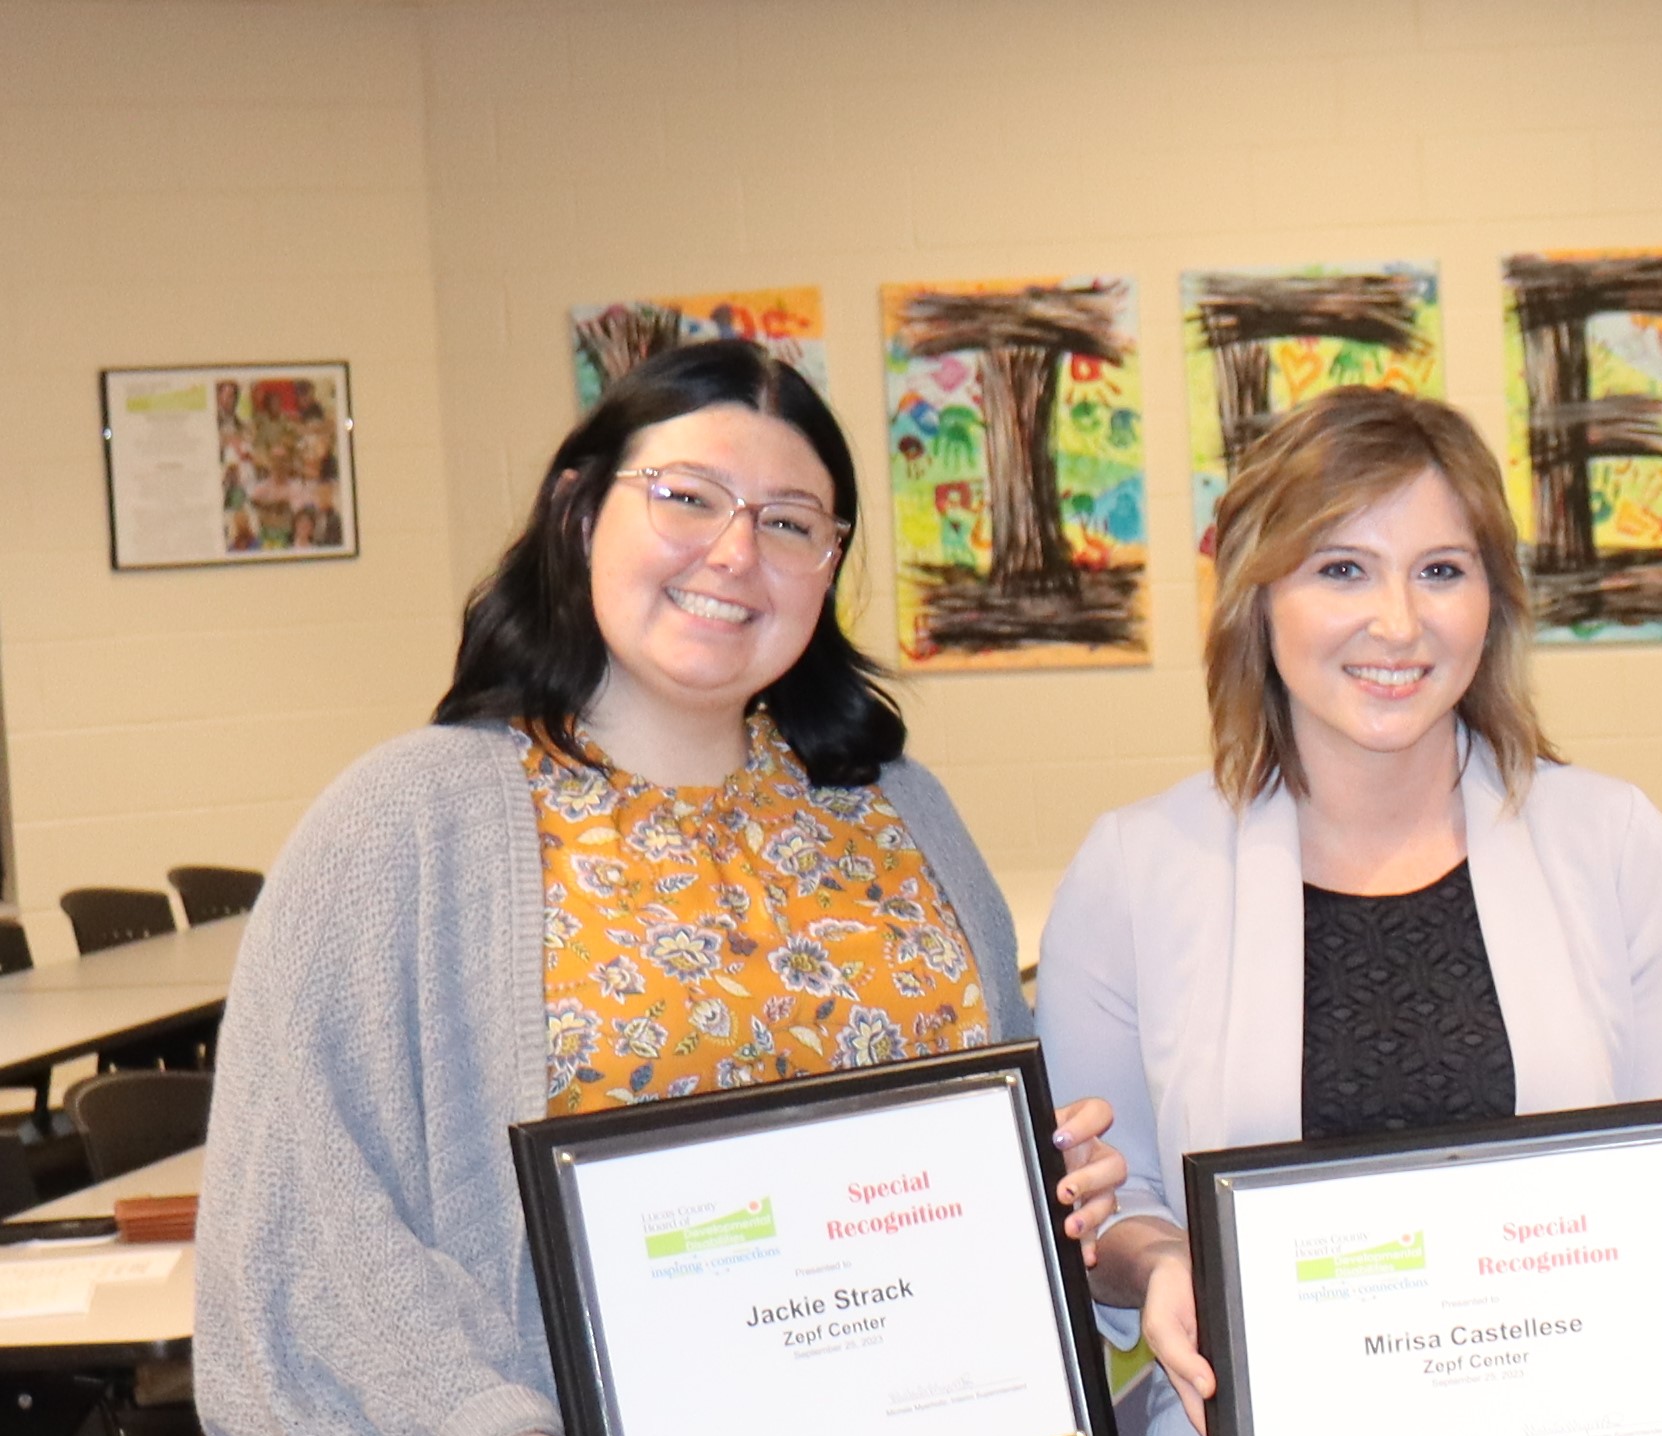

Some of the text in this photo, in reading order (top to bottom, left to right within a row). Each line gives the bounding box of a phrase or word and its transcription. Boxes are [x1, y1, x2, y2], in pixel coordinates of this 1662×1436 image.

[848, 1170, 931, 1204] Special
[678, 1201, 716, 1217] County
[826, 1201, 963, 1240] Recognition
[685, 1214, 773, 1236] Developmental
[1502, 1214, 1588, 1243] Special
[651, 1246, 782, 1279] inspiring connections
[1336, 1247, 1421, 1265] Developmental
[1478, 1246, 1619, 1275] Recognition
[746, 1278, 914, 1327] Jackie Strack
[1299, 1278, 1430, 1302] inspiring connections
[783, 1315, 887, 1346] Zepf Center
[1364, 1317, 1583, 1355] Mirisa Castellese
[1423, 1351, 1530, 1376] Zepf Center
